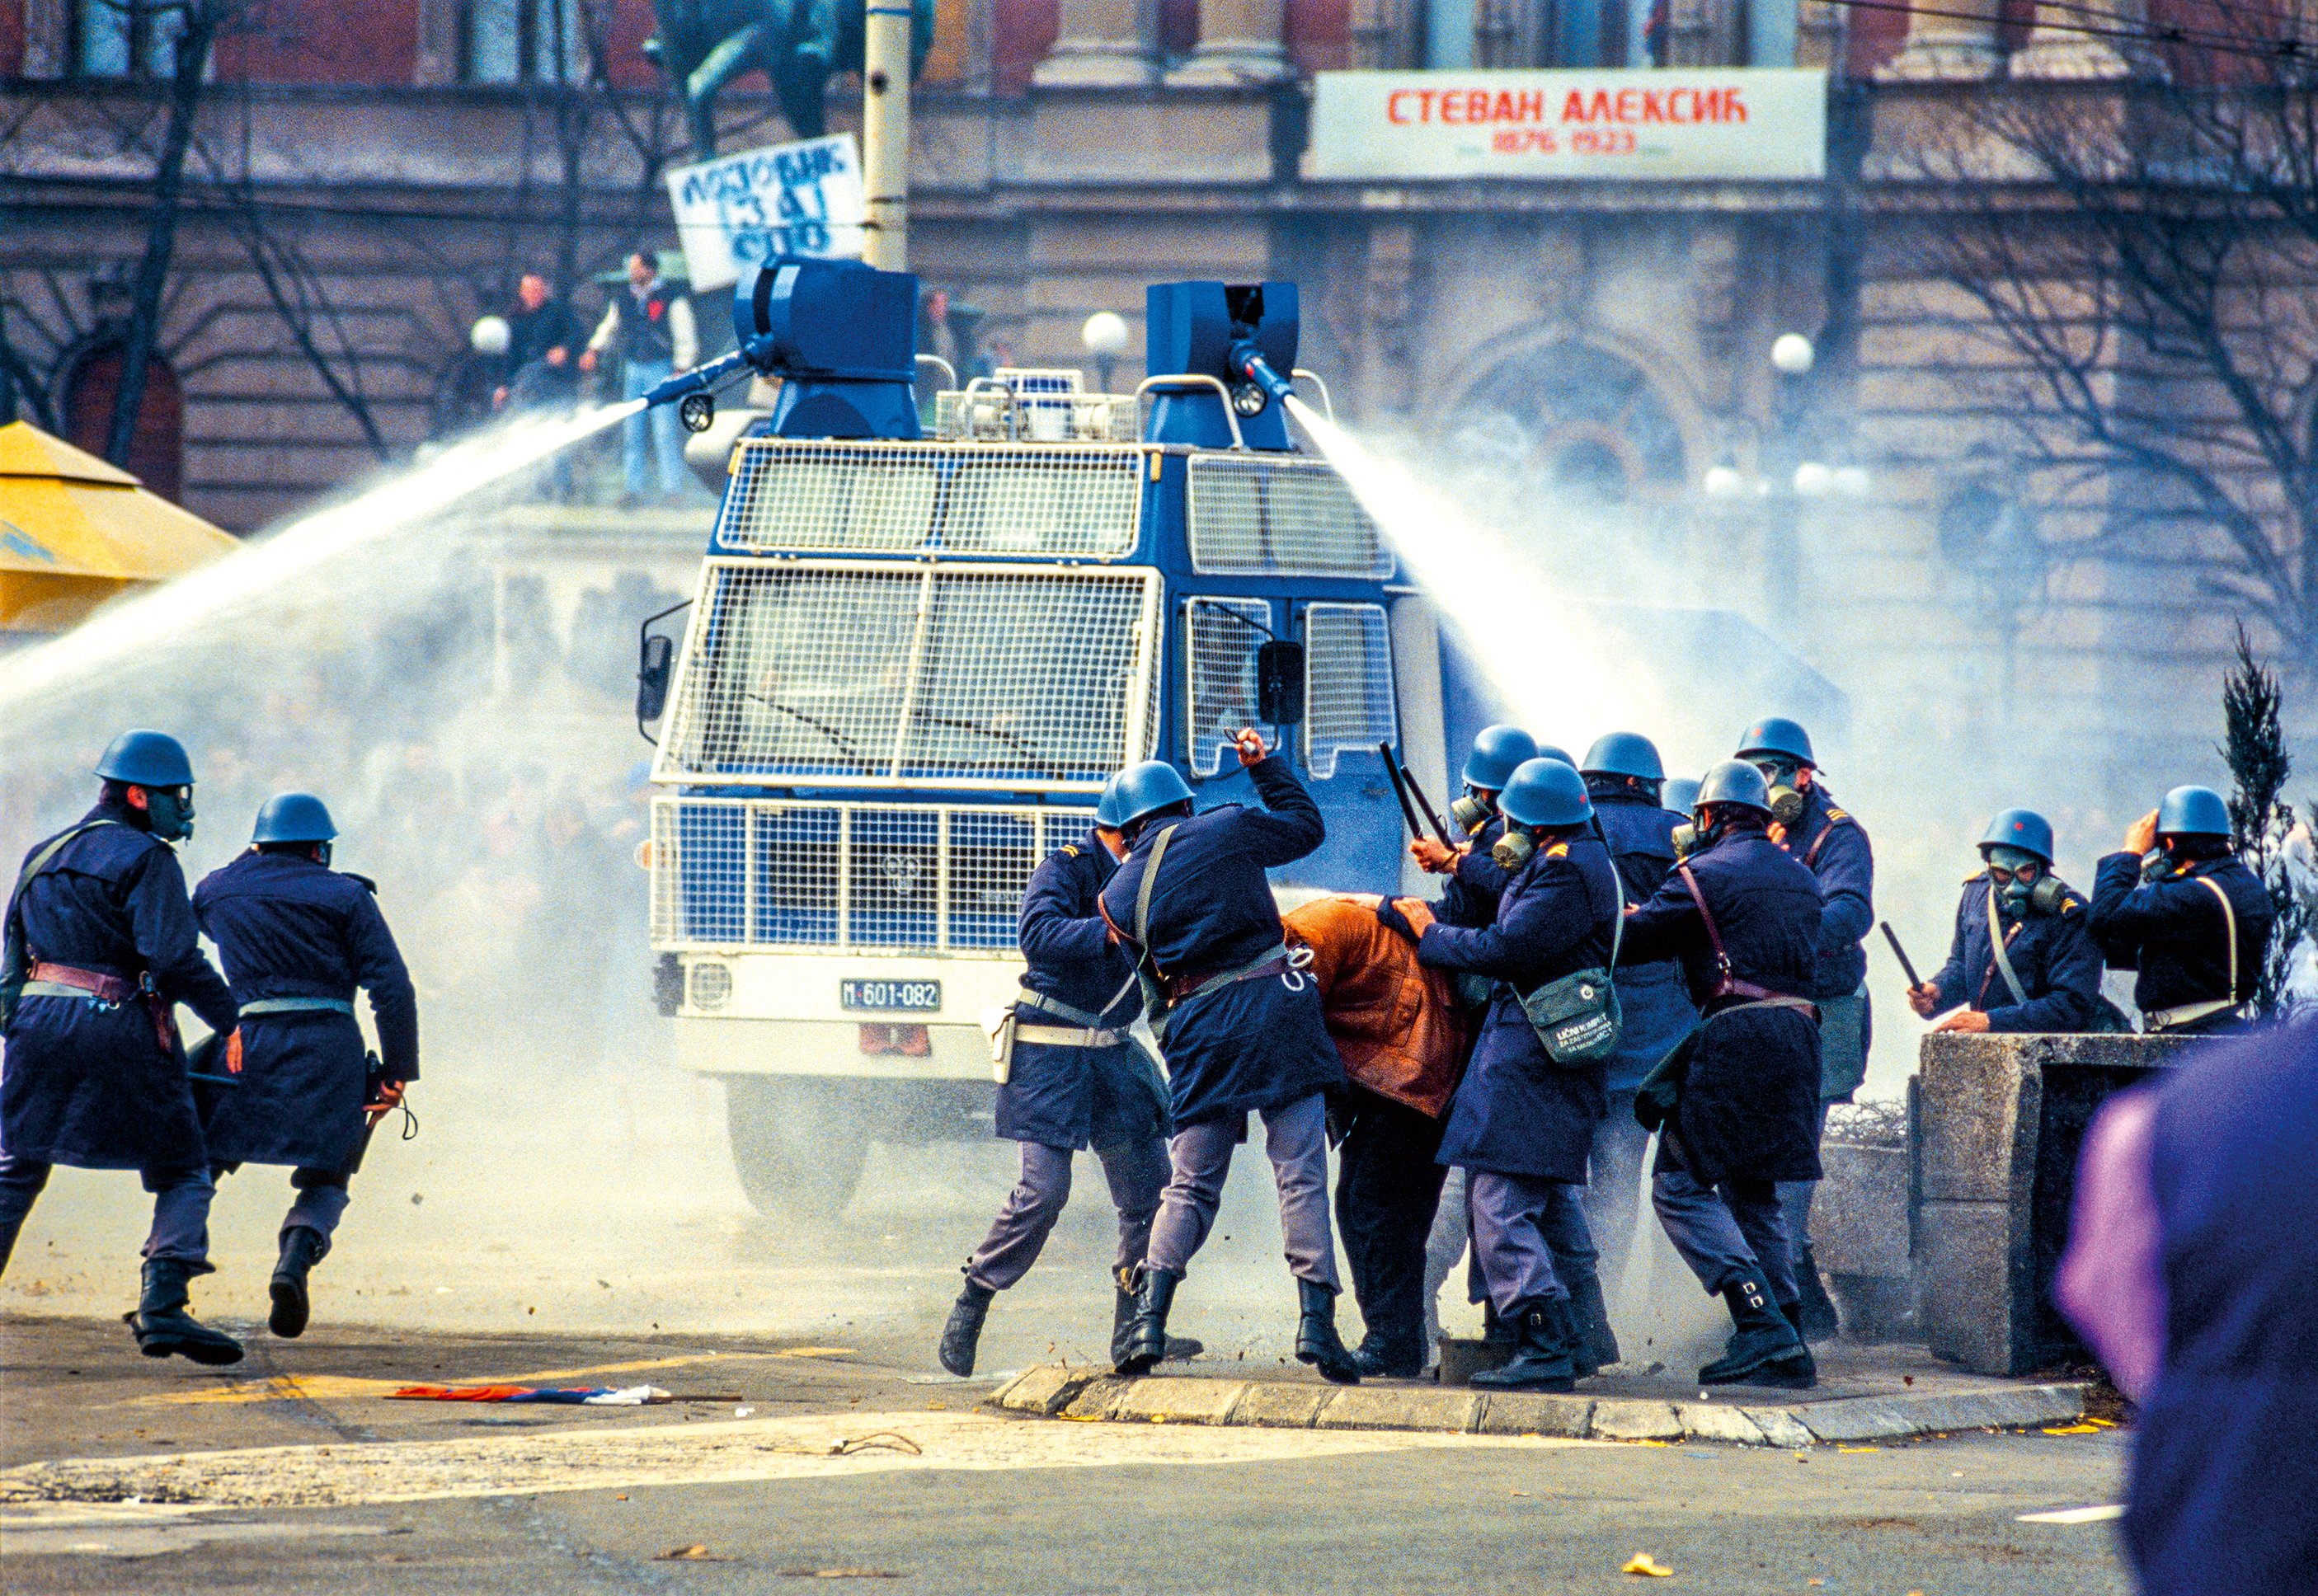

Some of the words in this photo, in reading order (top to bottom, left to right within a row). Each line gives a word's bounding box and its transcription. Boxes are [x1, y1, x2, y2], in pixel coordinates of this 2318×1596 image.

[1386, 87, 1545, 125] СТЕВАН
[1559, 87, 1749, 125] АЛЕКСИЋ
[863, 983, 937, 1006] 601-082
